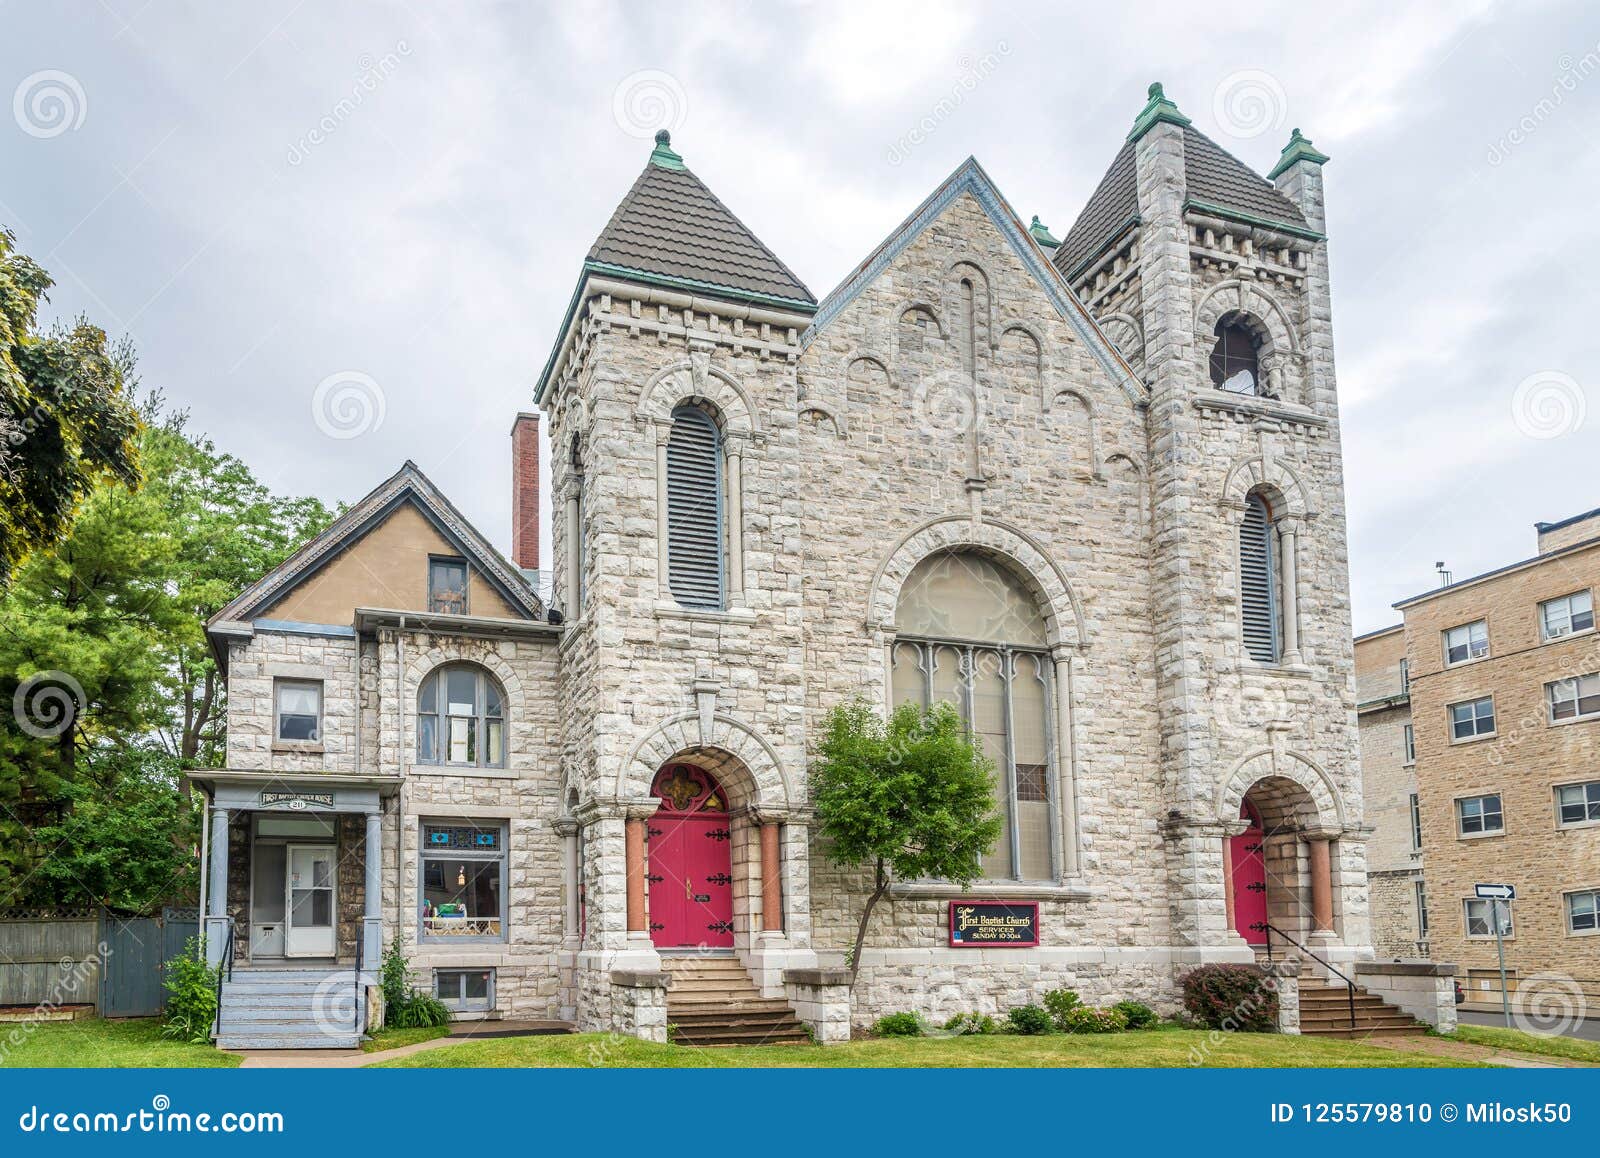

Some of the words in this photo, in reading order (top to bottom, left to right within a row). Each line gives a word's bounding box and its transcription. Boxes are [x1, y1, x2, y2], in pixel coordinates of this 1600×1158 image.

[957, 906, 978, 931] First
[980, 915, 1004, 925] Baptist
[1006, 915, 1030, 926] Church
